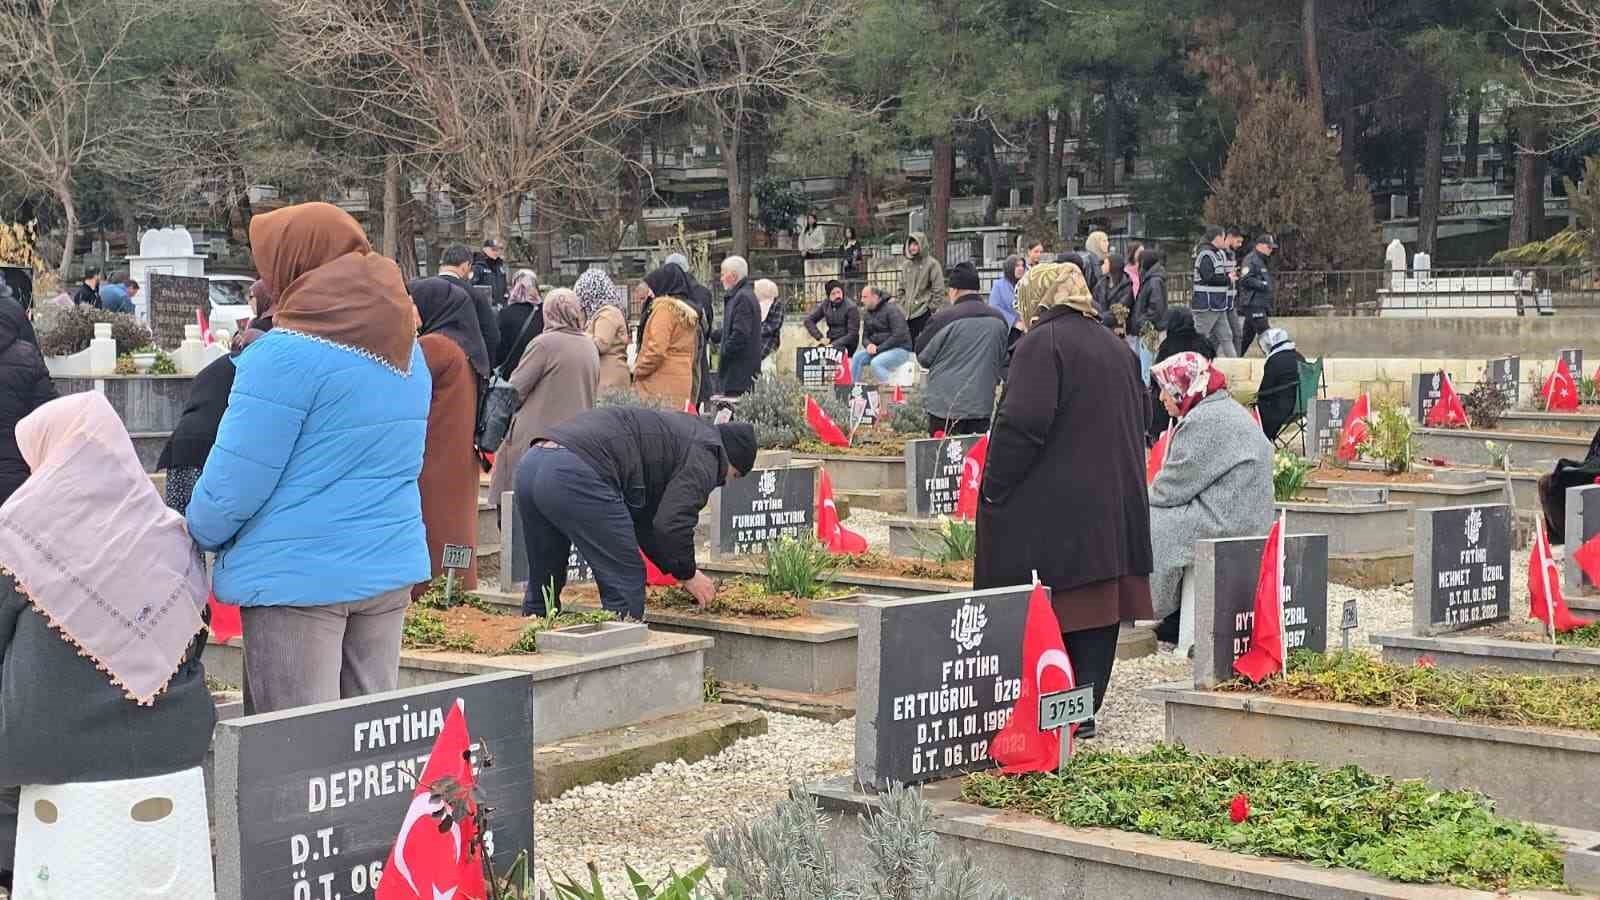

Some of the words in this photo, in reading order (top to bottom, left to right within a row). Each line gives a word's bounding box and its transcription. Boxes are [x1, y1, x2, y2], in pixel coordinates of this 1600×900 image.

[1460, 544, 1487, 564] FATİHA
[1438, 568, 1471, 589] MEHMET
[1482, 563, 1504, 582] ÖZBAL
[1284, 607, 1308, 626] ZBAL
[942, 650, 1000, 682] FATİHA
[892, 684, 979, 721] ERTUĞRUL
[1049, 695, 1085, 721] 3755
[353, 704, 444, 752] FATİHA
[917, 719, 946, 745] D.T.
[290, 827, 340, 865] D.T.
